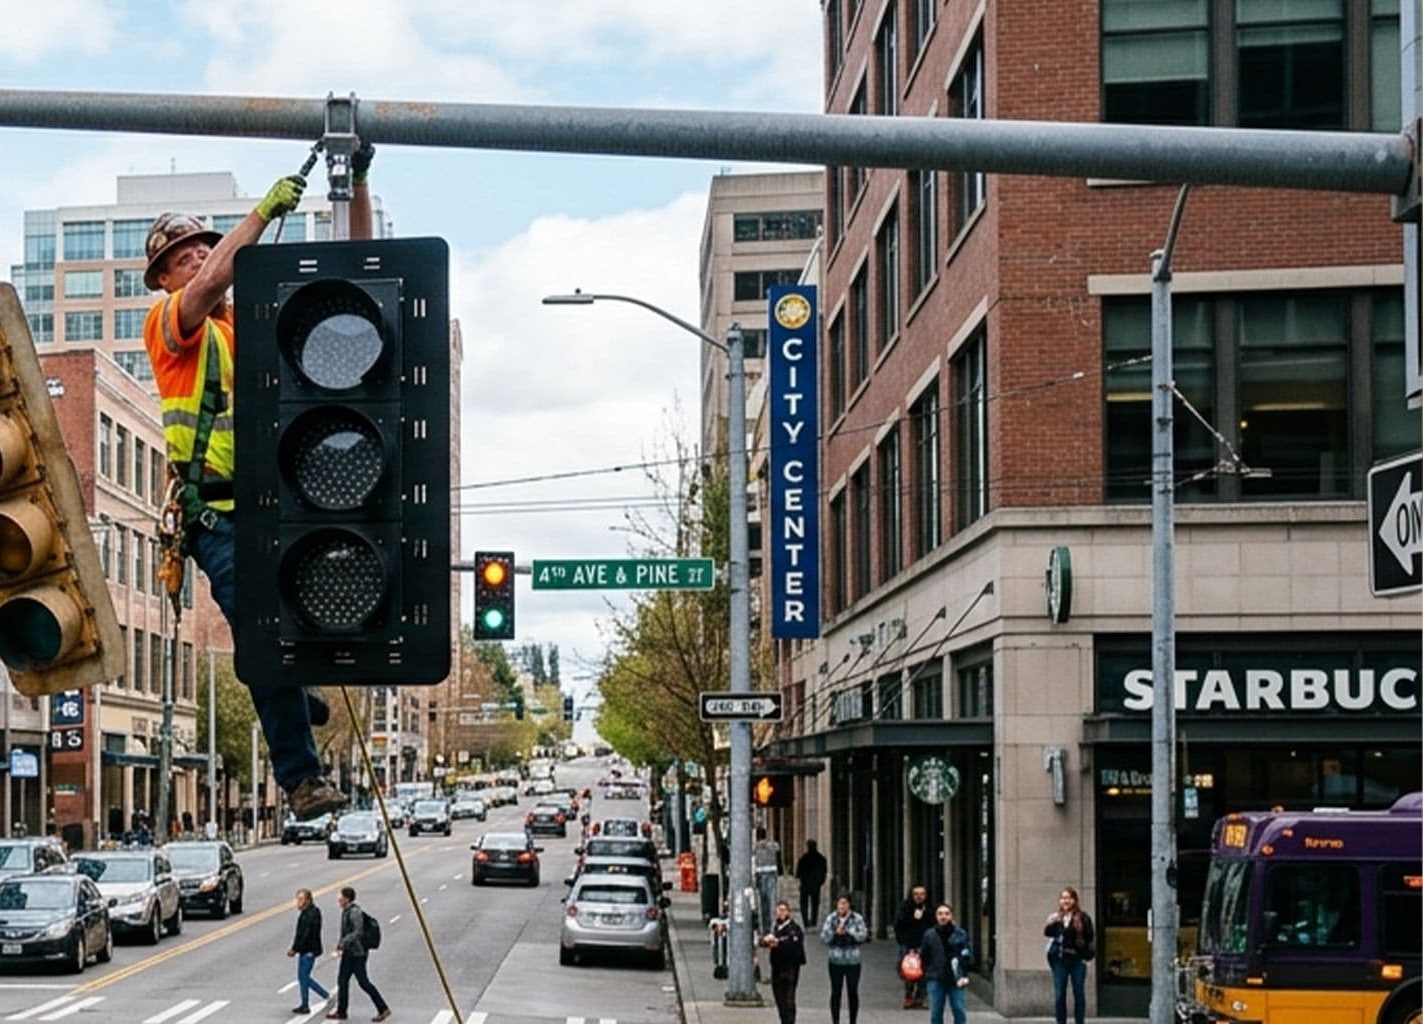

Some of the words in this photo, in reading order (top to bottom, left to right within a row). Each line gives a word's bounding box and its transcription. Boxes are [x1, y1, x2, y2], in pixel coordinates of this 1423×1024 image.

[782, 338, 804, 444] CITY
[572, 564, 608, 584] AVE
[615, 567, 626, 584] &
[636, 564, 679, 584] PINE
[783, 460, 805, 622] CENTER
